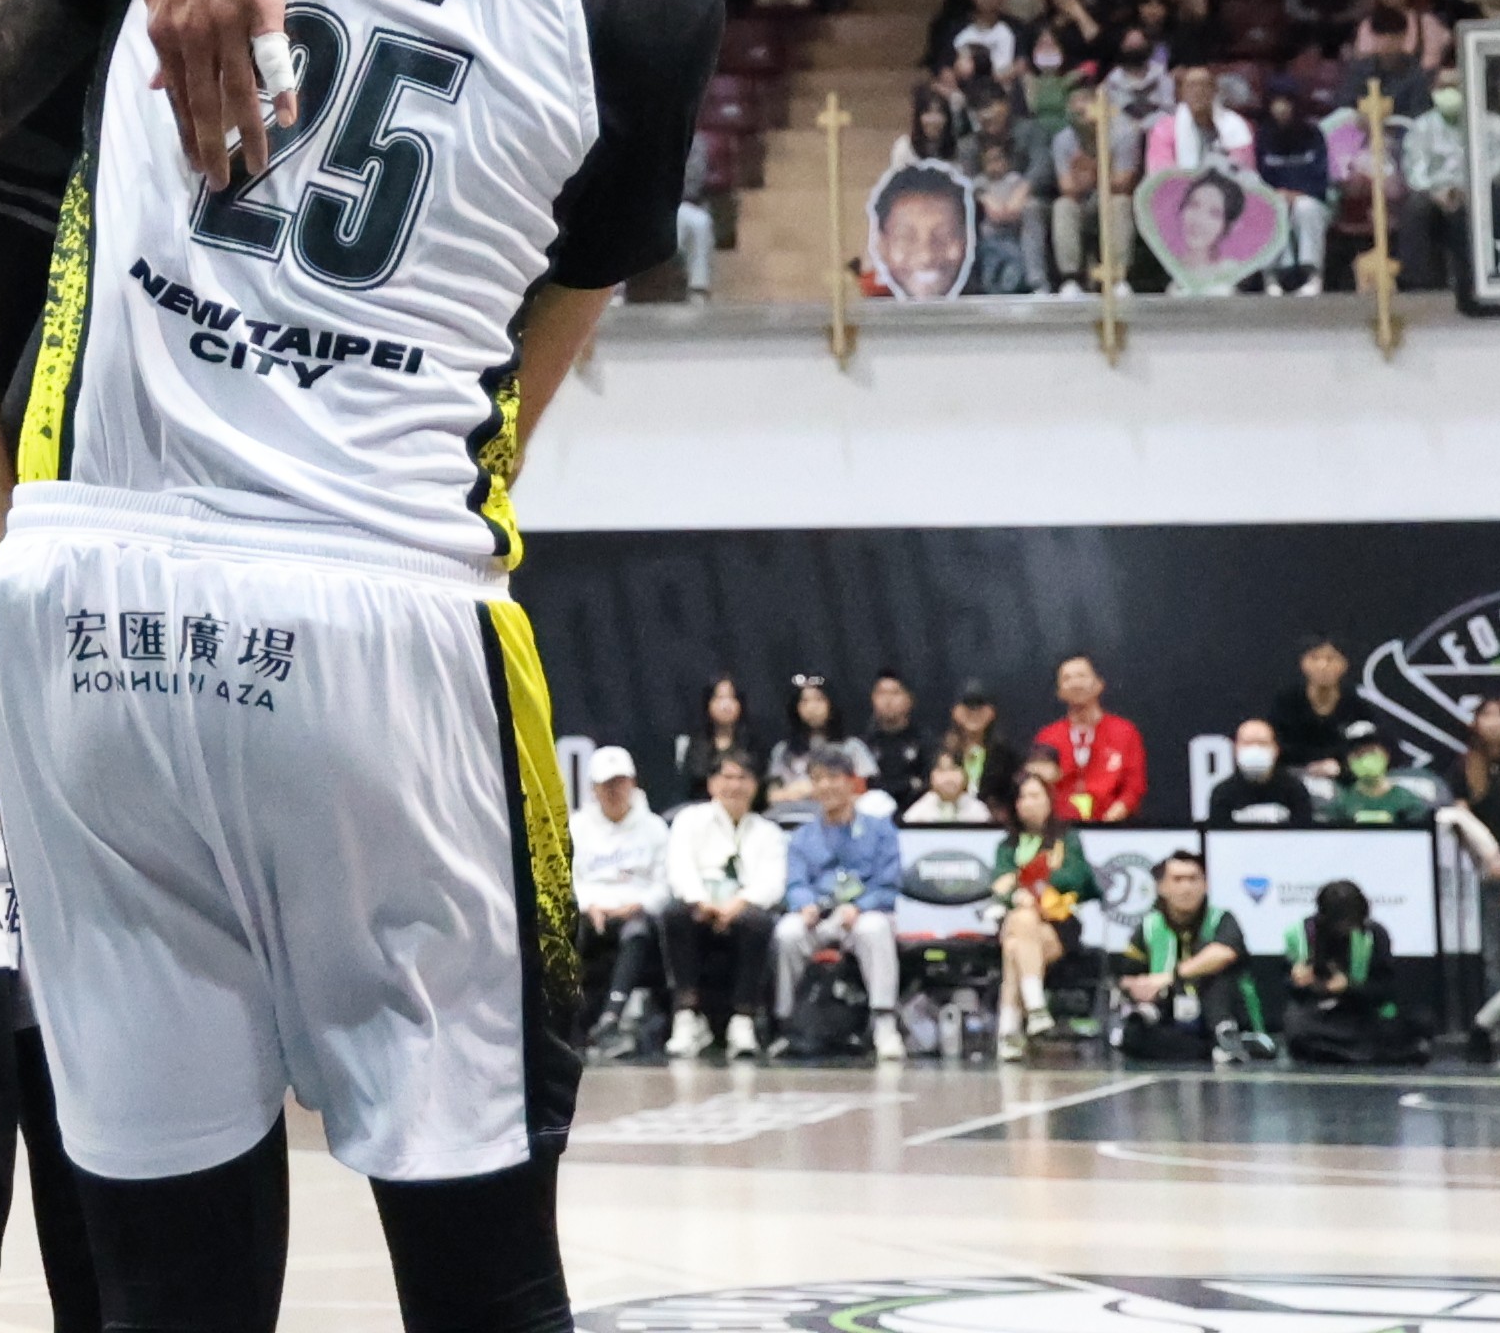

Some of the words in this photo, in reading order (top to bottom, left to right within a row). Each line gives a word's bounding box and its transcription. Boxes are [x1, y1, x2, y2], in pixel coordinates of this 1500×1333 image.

[188, 1, 474, 292] 25
[129, 258, 244, 332] NEW
[245, 319, 425, 374] TAIPEI
[189, 336, 333, 390] CITY
[65, 608, 296, 682] 宏匯廣場
